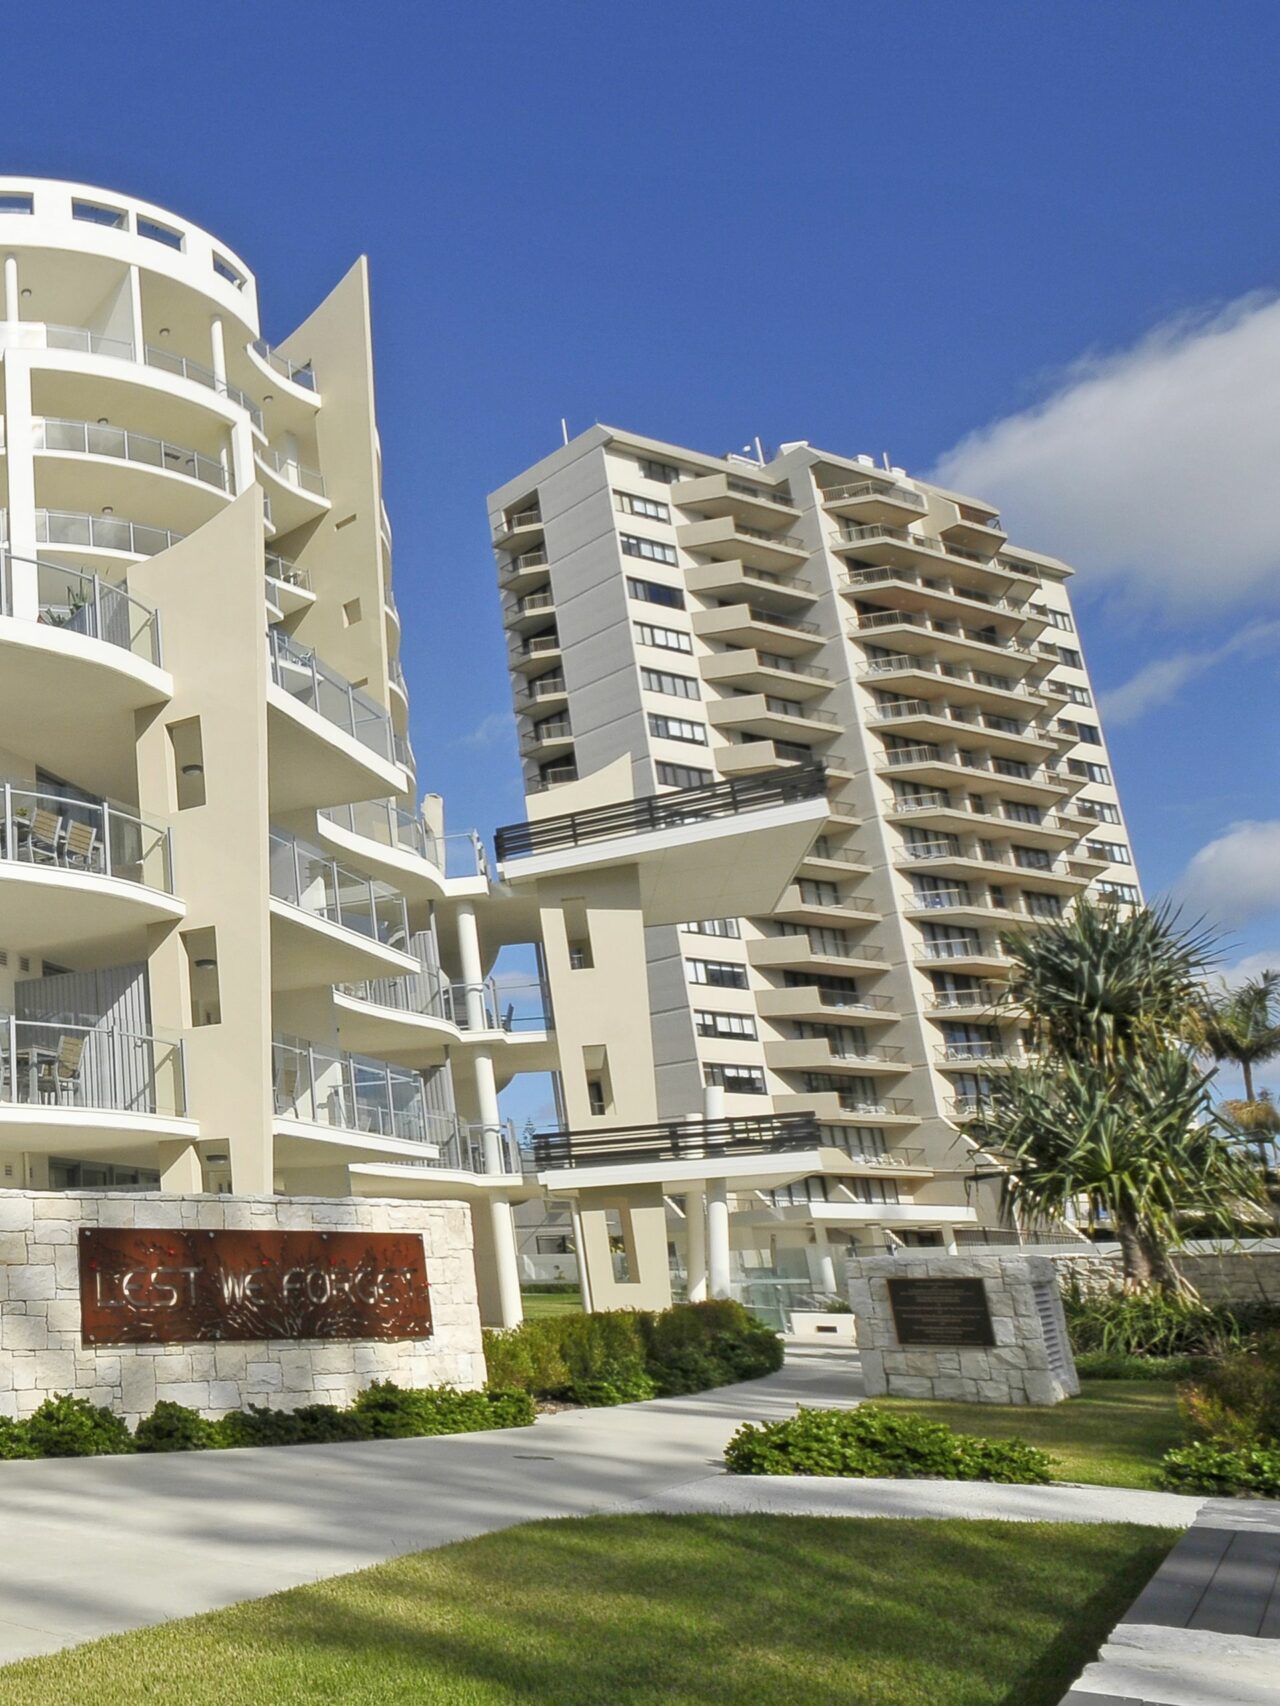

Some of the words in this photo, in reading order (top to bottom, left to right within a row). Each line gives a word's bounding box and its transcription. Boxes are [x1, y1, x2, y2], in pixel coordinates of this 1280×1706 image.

[96, 1266, 203, 1307] LEST
[219, 1266, 271, 1305] WE
[283, 1266, 417, 1305] FORGET
